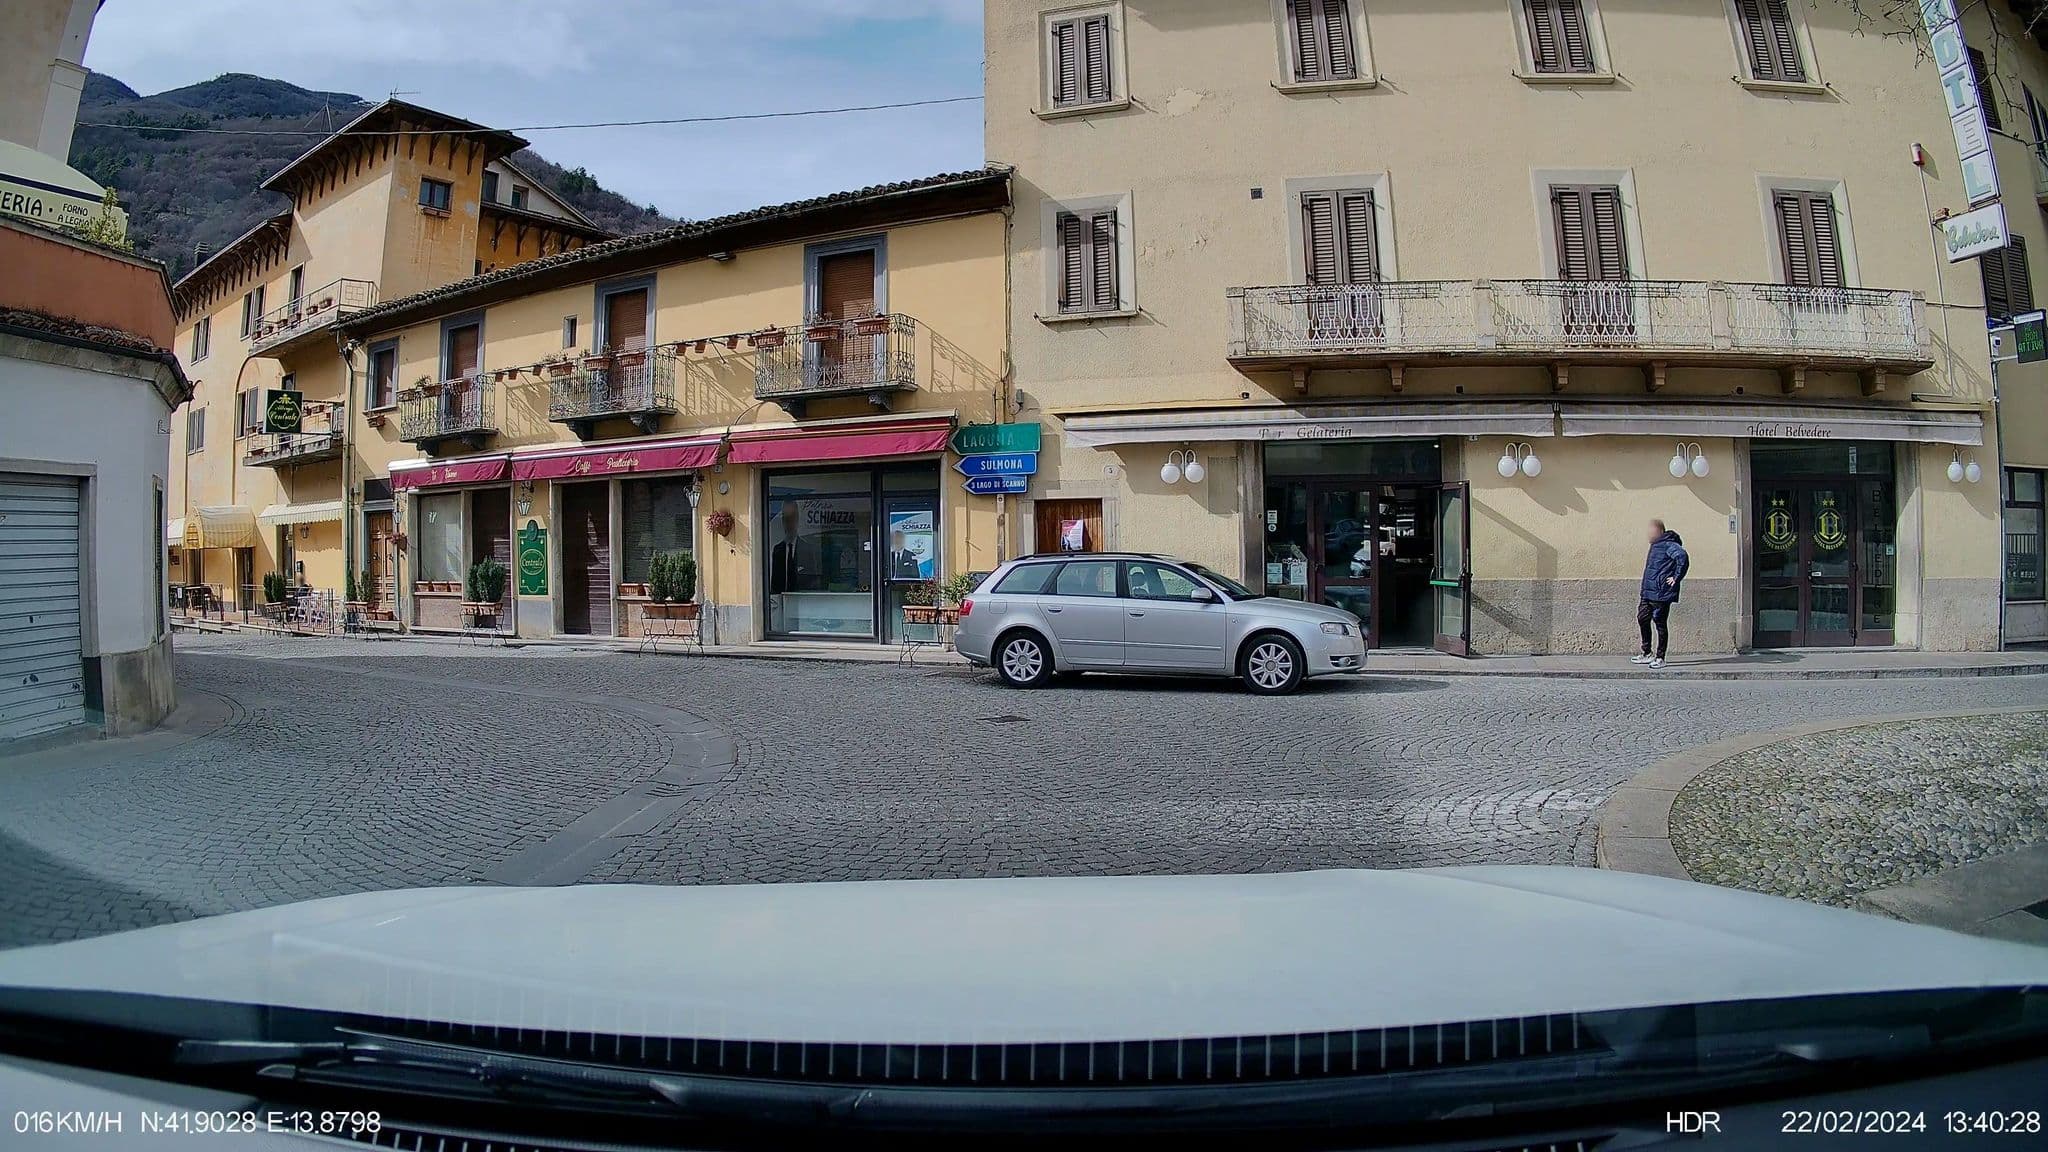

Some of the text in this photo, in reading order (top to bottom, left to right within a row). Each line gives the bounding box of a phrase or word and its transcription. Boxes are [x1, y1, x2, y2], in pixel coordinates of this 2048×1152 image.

[0, 189, 43, 217] ERIA
[62, 203, 89, 216] FORNO
[57, 214, 64, 222] A
[1296, 425, 1353, 438] Gelateria
[1746, 421, 1832, 438] Hotel Belvedere
[980, 459, 1023, 471] SULMONA
[976, 481, 992, 489] LAGO
[993, 481, 1000, 489] DI
[1002, 480, 1025, 488] SCANNO
[806, 510, 856, 525] SCHIAZZA
[901, 523, 932, 531] SCHIAZZA
